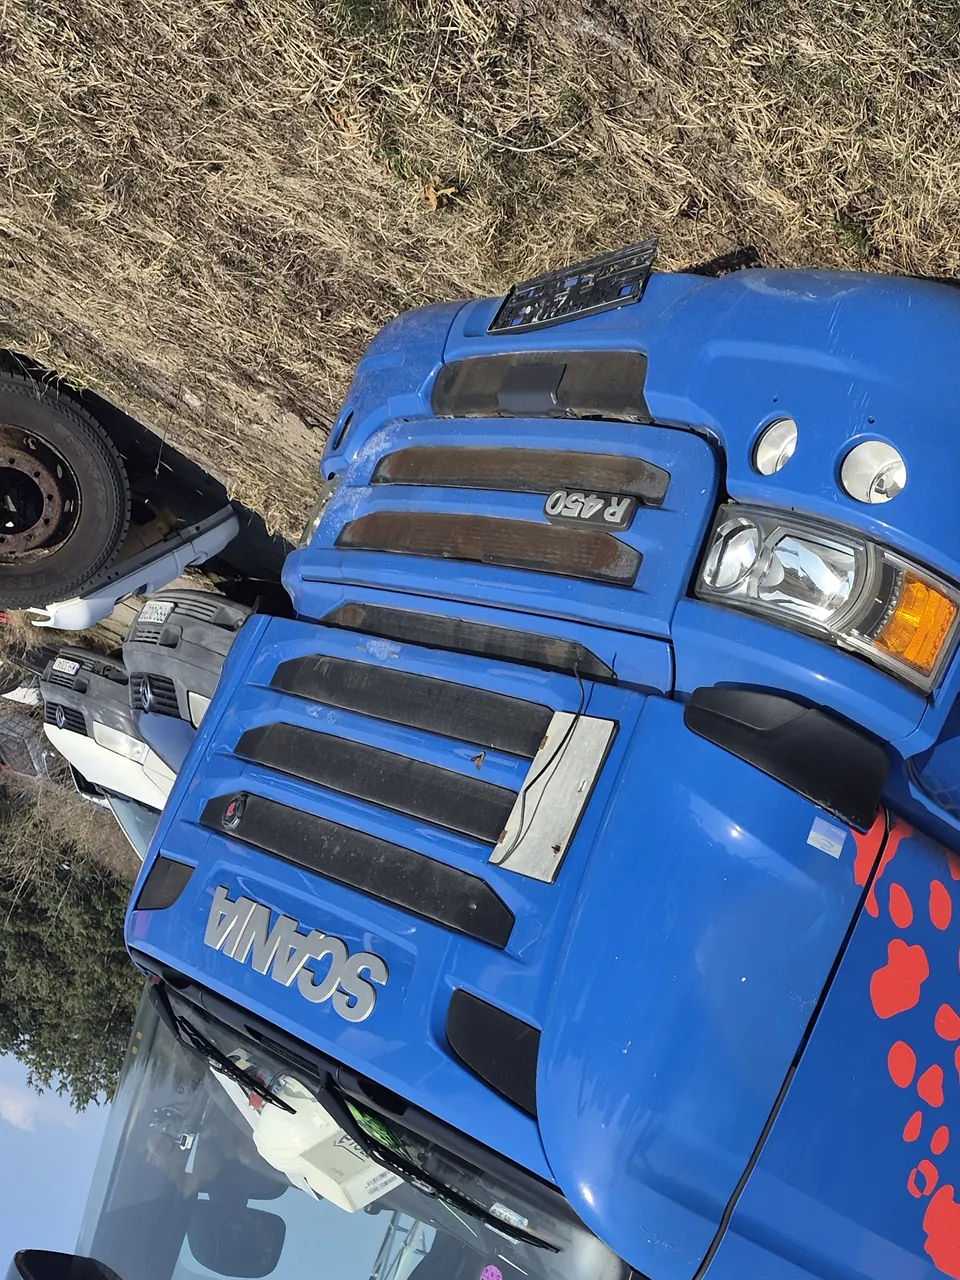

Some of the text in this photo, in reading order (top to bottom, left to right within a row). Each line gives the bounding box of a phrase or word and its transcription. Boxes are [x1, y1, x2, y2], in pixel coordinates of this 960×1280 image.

[545, 489, 631, 523] R 450
[204, 885, 389, 1023] SCANIA
